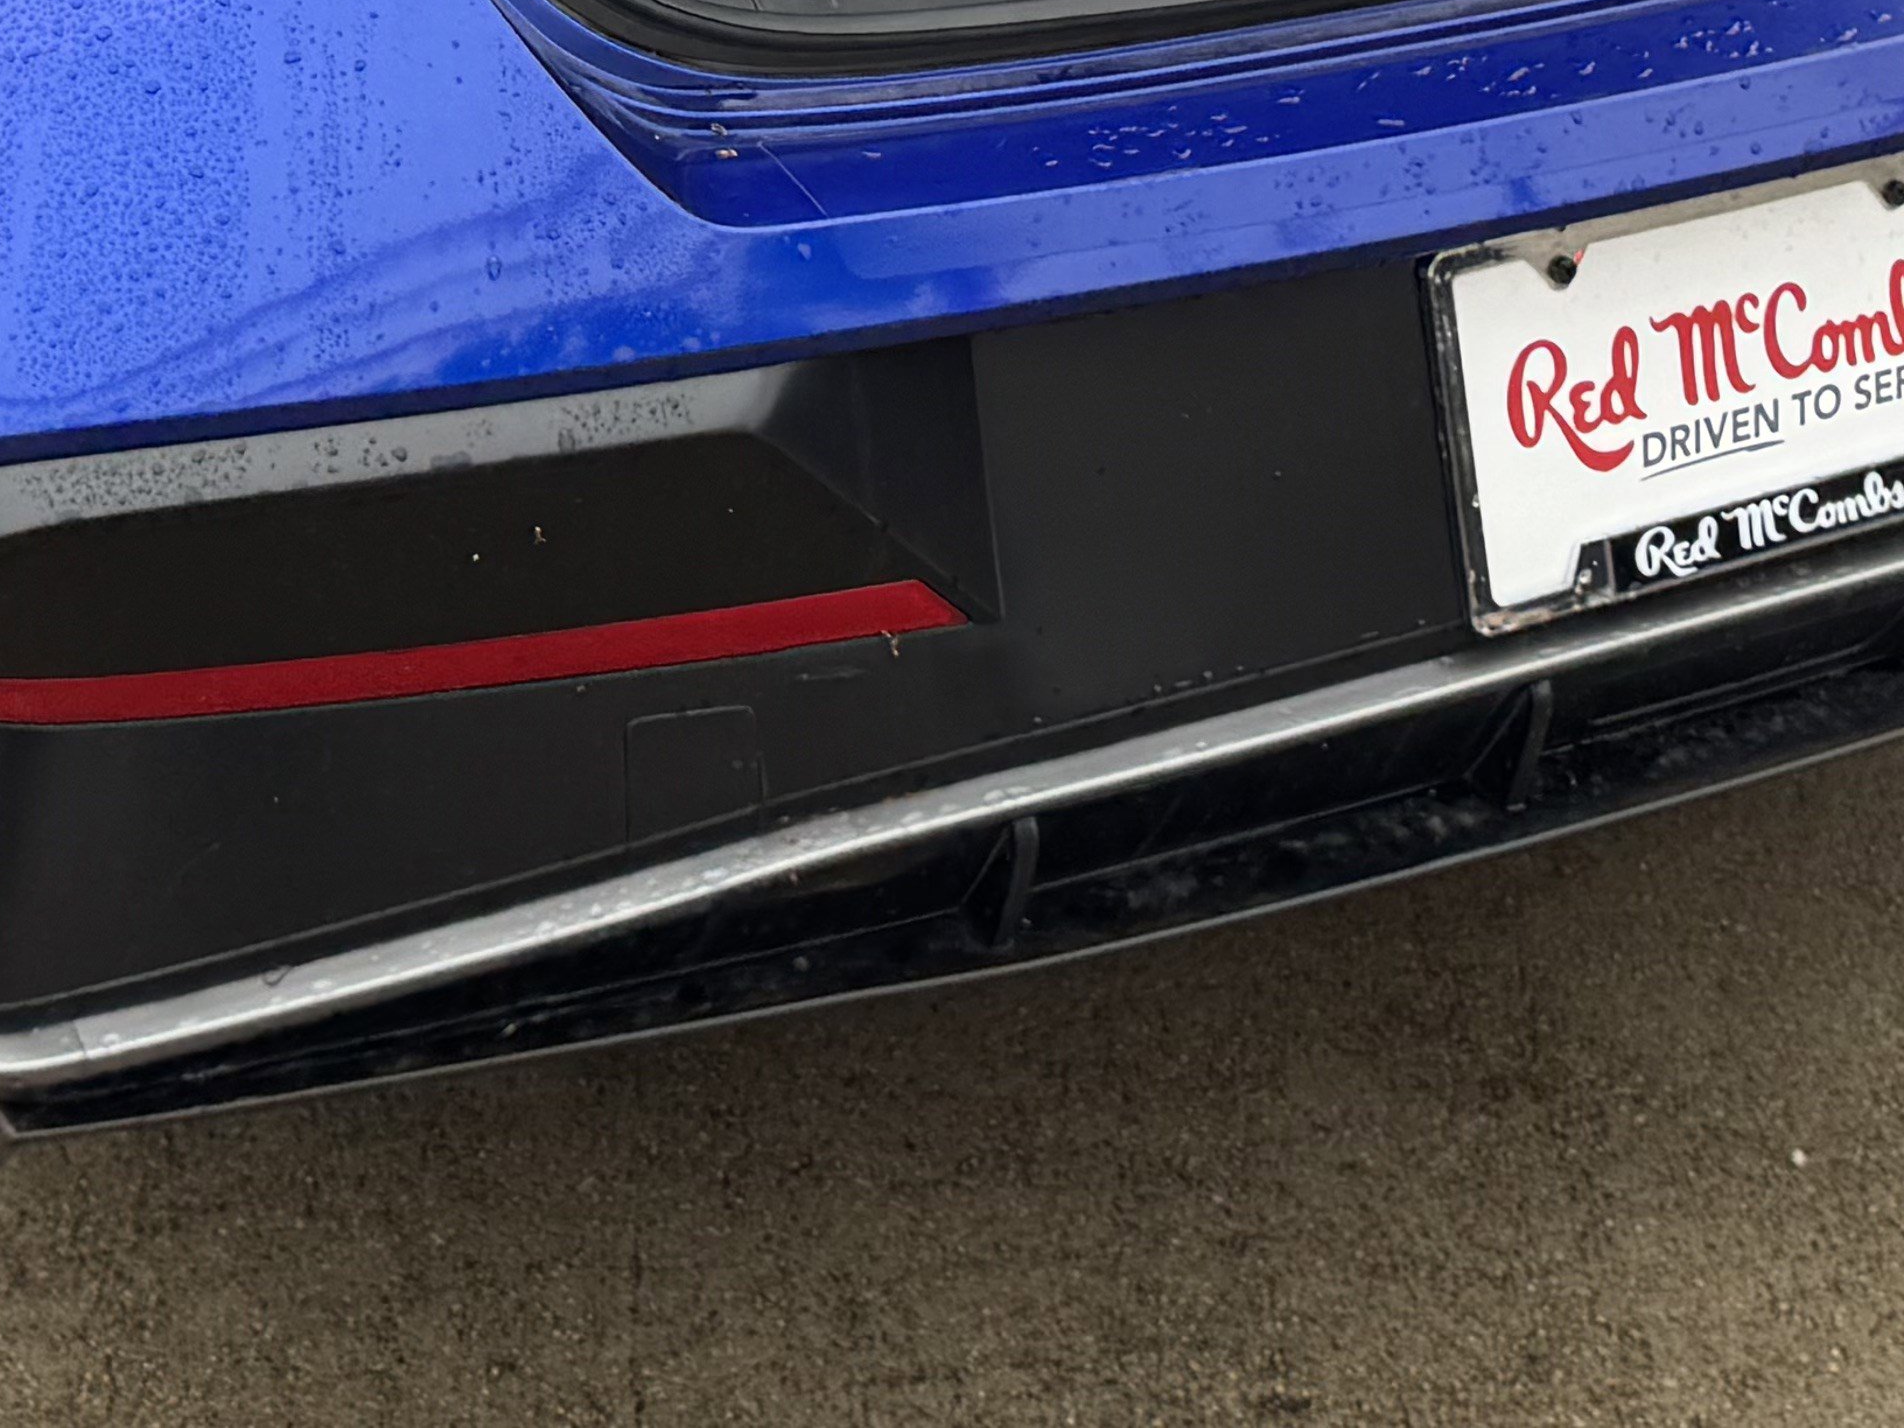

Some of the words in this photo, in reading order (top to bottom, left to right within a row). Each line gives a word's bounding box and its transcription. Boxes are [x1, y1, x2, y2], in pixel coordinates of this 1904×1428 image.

[1507, 325, 1647, 473] Red
[1641, 398, 1781, 469] DRIVEN
[1790, 384, 1841, 426] TO
[1634, 518, 1721, 578] Red
